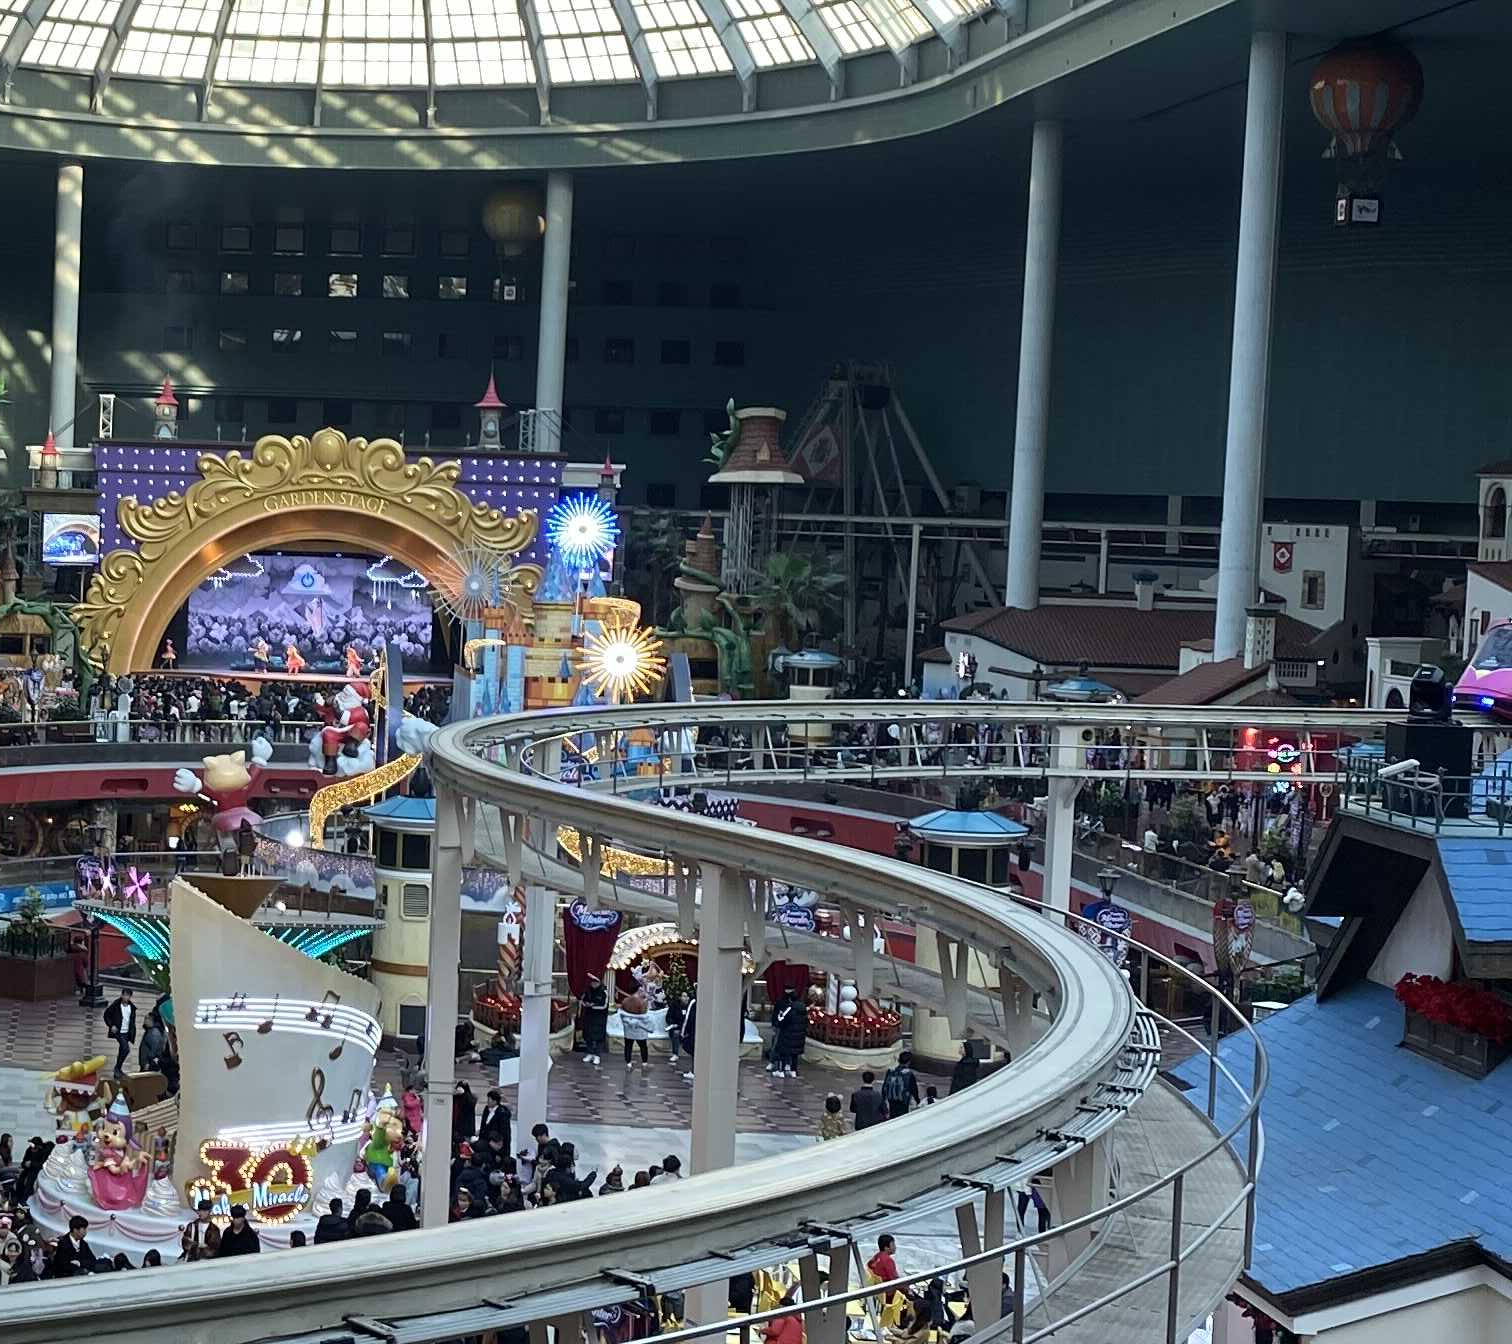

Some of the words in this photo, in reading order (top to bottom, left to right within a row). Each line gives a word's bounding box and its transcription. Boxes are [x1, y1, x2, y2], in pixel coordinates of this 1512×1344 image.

[263, 491, 335, 513] GARDEN
[338, 491, 389, 515] STAGE
[252, 1182, 310, 1210] Miracle
